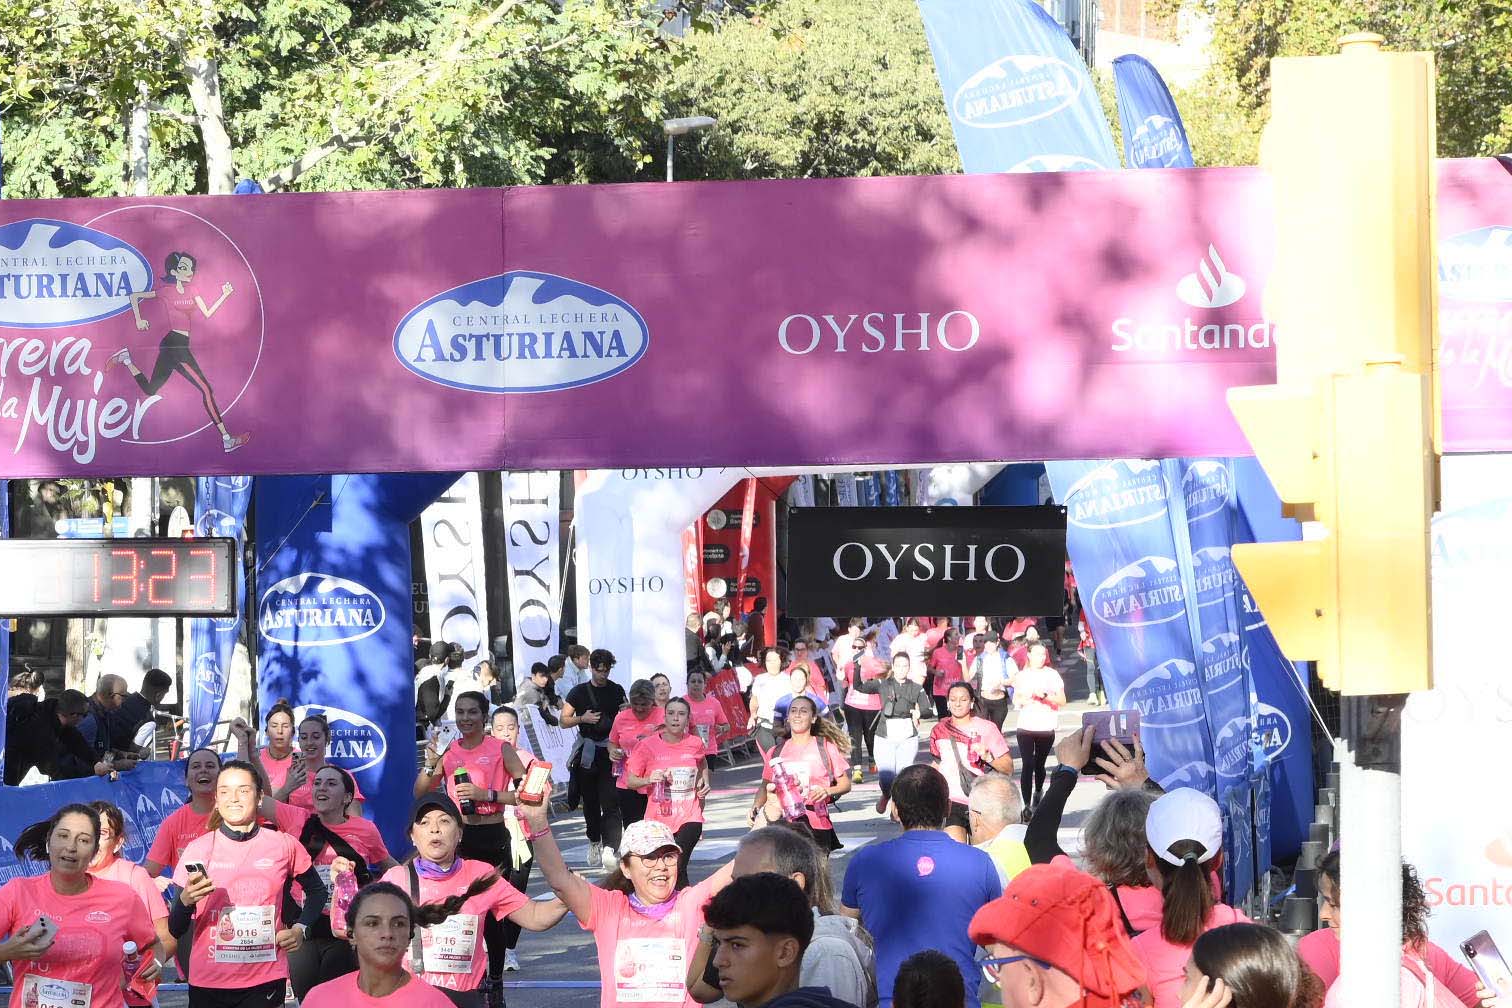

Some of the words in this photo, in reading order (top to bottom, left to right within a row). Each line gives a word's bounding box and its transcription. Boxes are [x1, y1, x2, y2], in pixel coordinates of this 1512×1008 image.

[55, 255, 128, 267] LECHERA
[452, 313, 531, 327] CENTRAL
[539, 311, 621, 326] LECHERA
[413, 318, 629, 363] ASTURIANA
[778, 310, 981, 355] OYSHO
[1111, 317, 1279, 353] Santand
[14, 371, 163, 465] Mujer
[832, 541, 1027, 583] OYSHO
[588, 576, 664, 596] OYSHO
[275, 598, 319, 607] CENTRAL
[323, 597, 372, 606] LECHERA
[263, 603, 377, 631] ASTURIANA
[329, 729, 373, 738] ECHERA
[237, 928, 258, 937] 016
